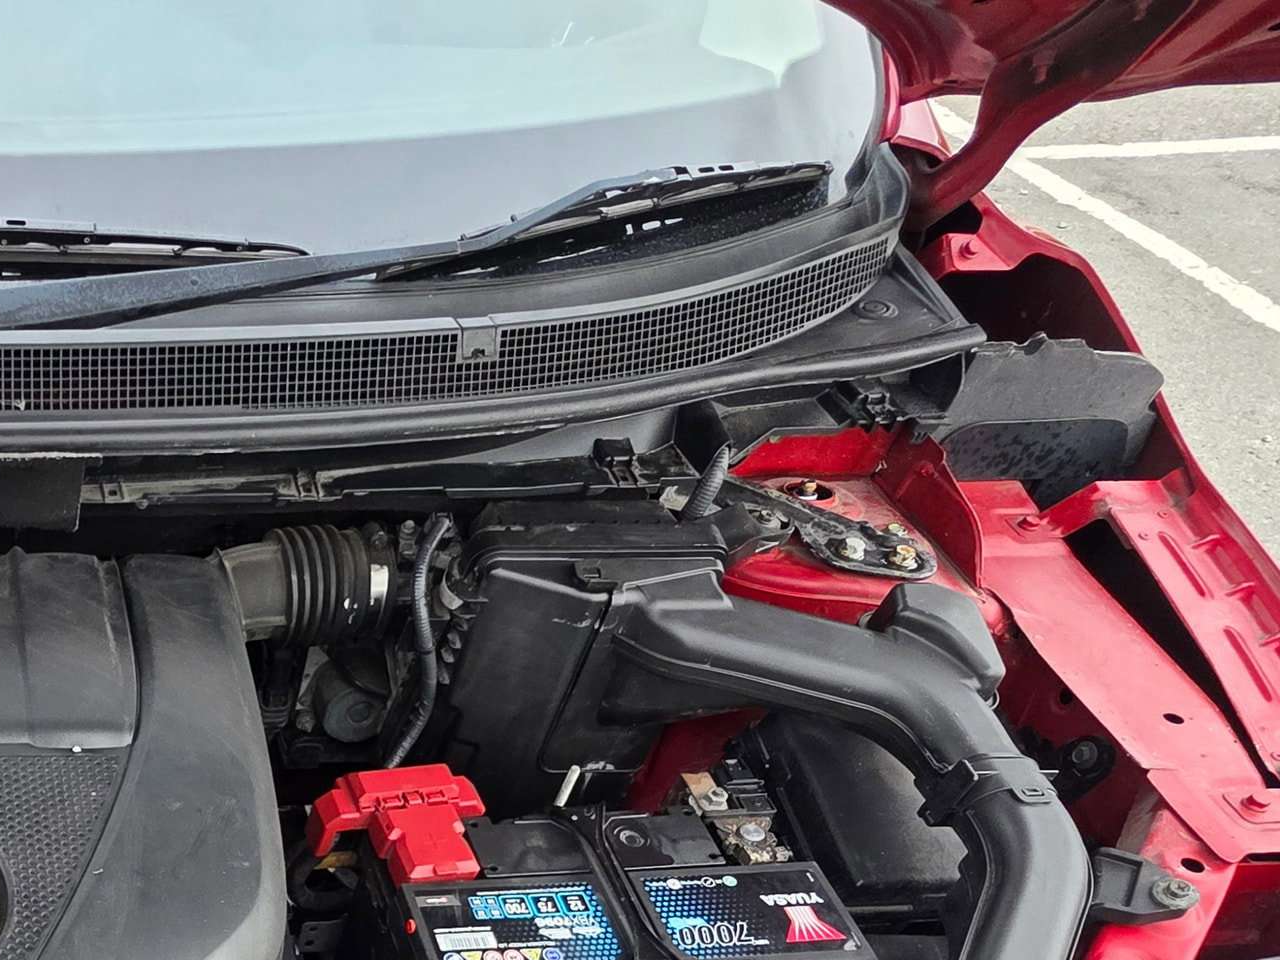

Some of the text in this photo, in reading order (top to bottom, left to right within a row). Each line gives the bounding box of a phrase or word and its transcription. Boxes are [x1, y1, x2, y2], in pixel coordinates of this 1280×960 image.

[759, 892, 825, 907] YUASA
[505, 903, 530, 915] 700
[537, 902, 557, 913] 75
[677, 921, 755, 948] 7000
